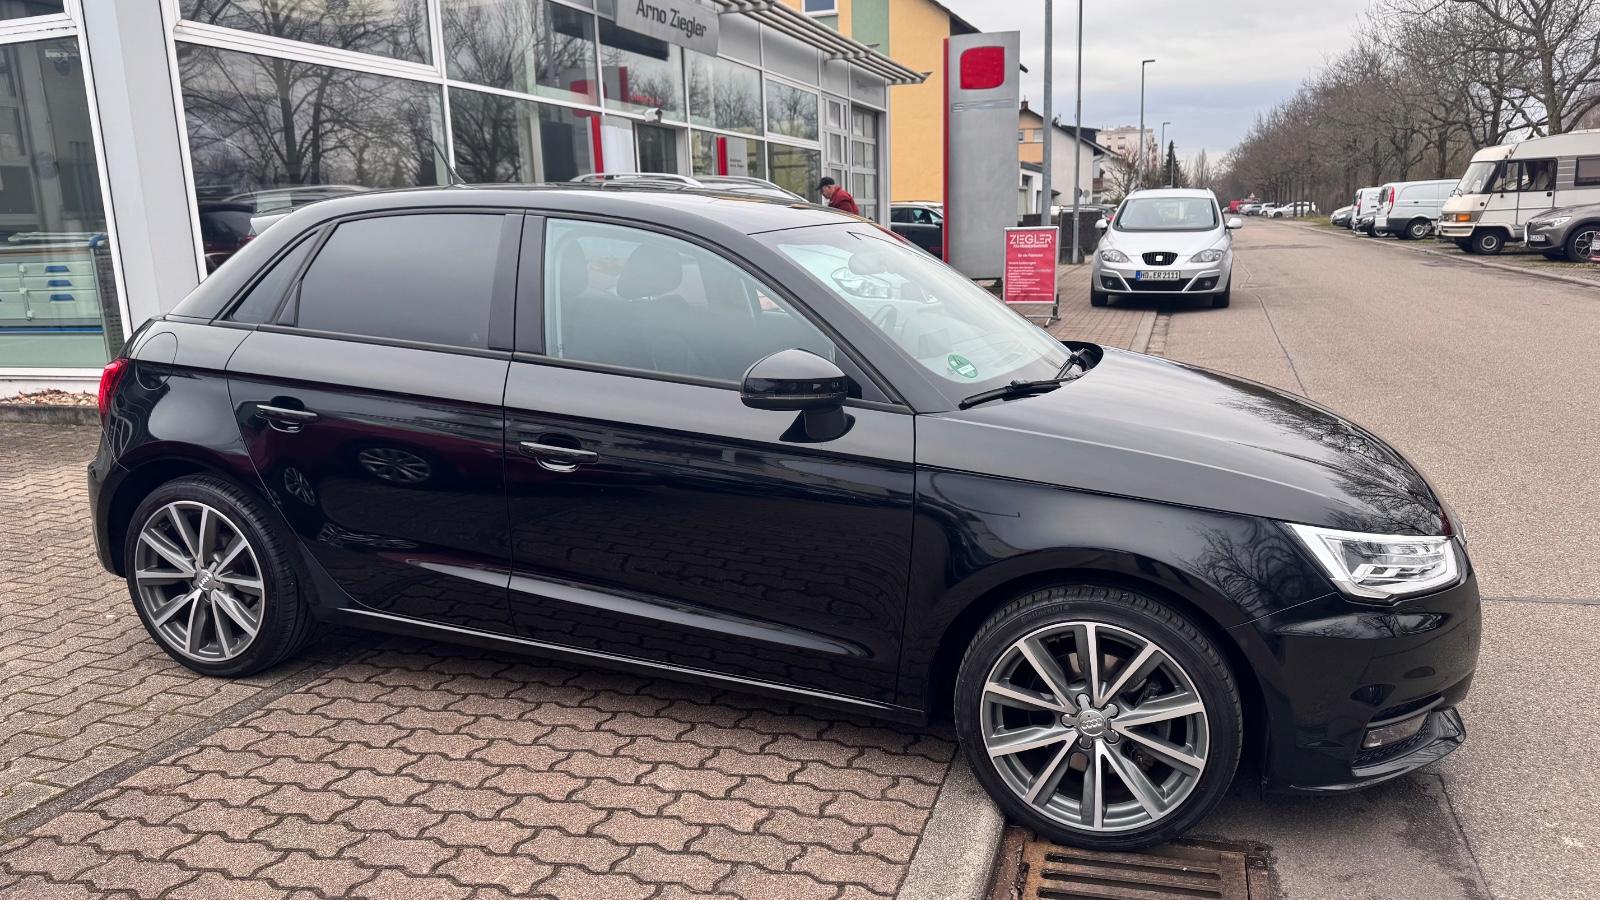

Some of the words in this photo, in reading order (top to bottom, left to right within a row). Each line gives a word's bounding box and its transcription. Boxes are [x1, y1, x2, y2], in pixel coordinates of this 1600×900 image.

[636, 0, 667, 24] Arno
[669, 8, 707, 38] Ziegler
[1010, 234, 1052, 244] ZIEGLER
